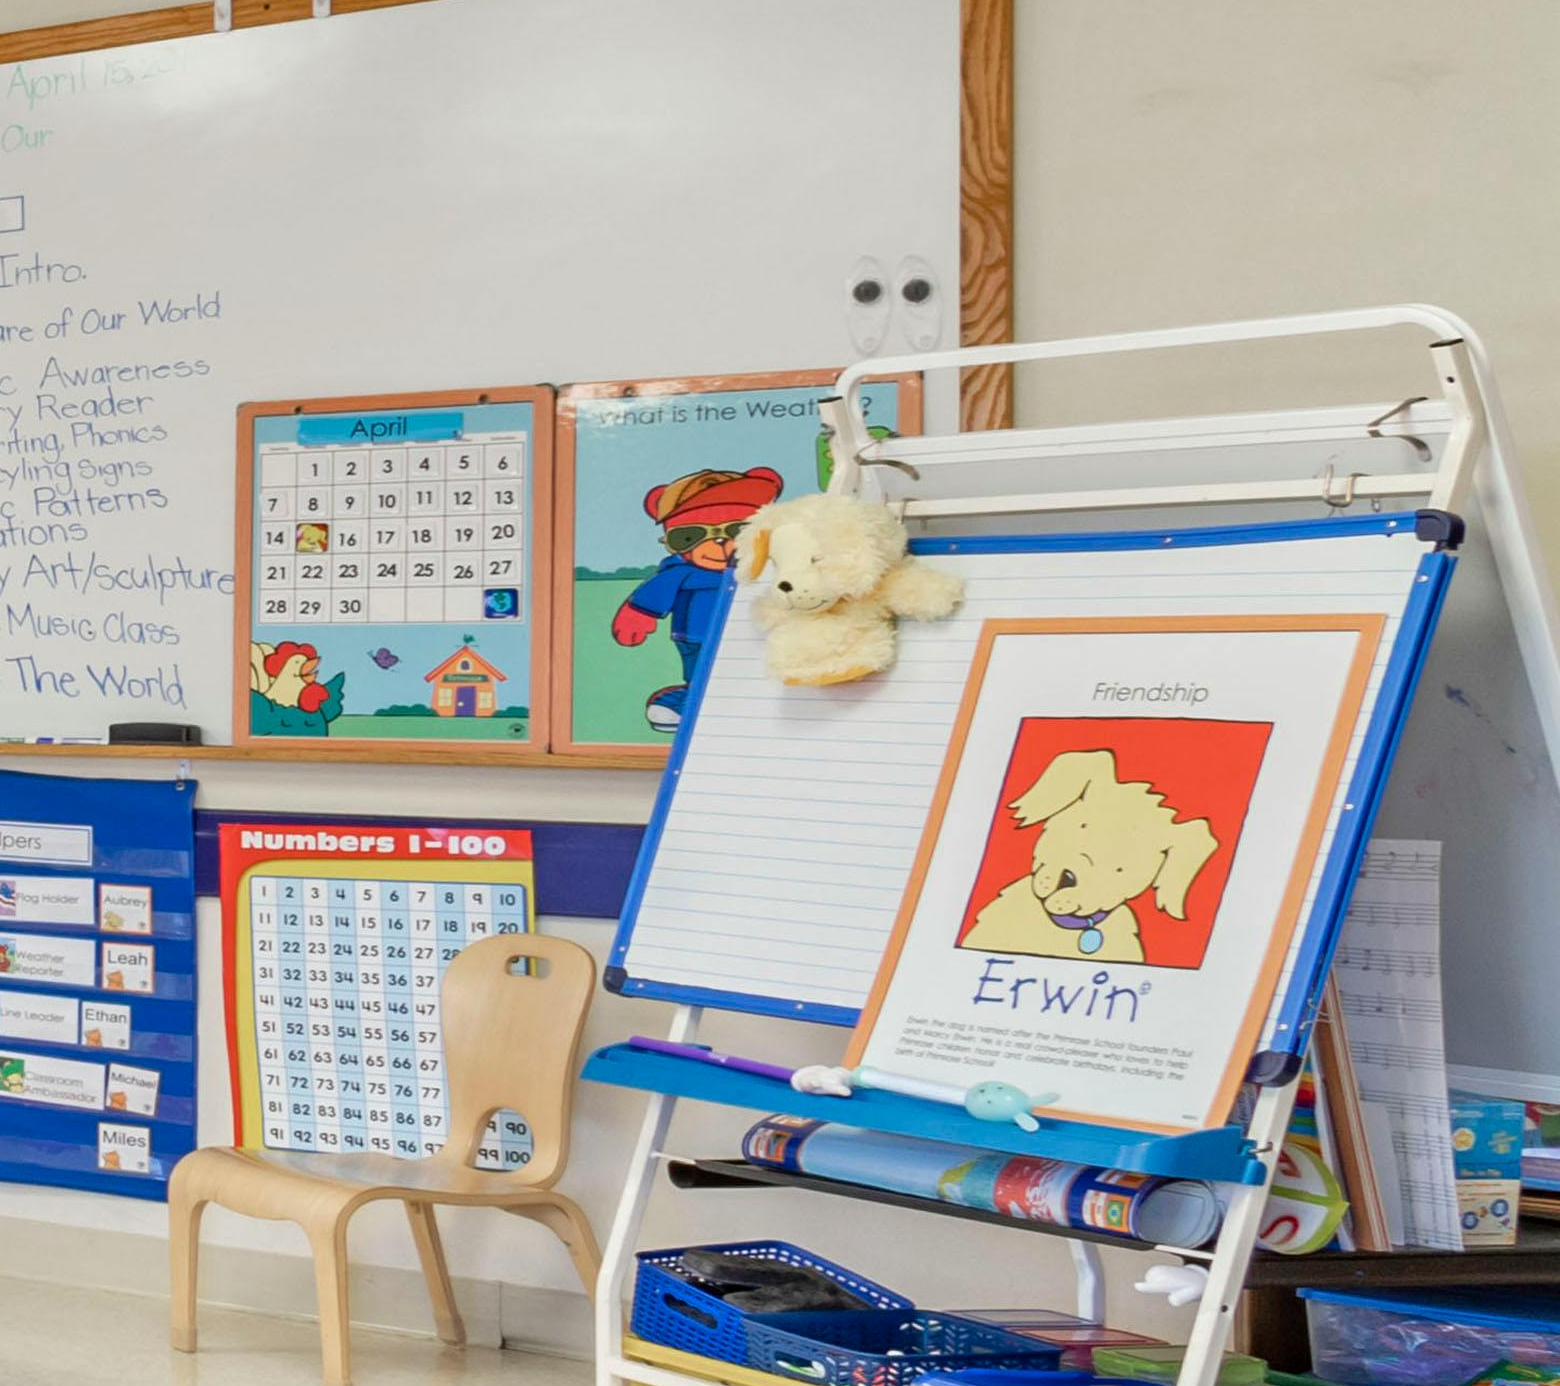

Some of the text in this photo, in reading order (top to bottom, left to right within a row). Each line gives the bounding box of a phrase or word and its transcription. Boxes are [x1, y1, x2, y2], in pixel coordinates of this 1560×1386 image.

[44, 306, 72, 339] of
[80, 307, 127, 335] Our
[138, 290, 221, 326] World
[38, 355, 211, 390] Awareness
[35, 386, 154, 421] Reader
[672, 406, 688, 423] is
[695, 403, 737, 422] the
[70, 421, 168, 450] Phonics
[349, 415, 408, 443] April
[33, 485, 169, 517] Patterns
[266, 598, 362, 616] 28 29 30
[6, 602, 97, 642] Music
[103, 610, 181, 646] Class
[5, 654, 80, 698] The
[86, 663, 188, 710] World
[1092, 681, 1210, 706] Friendship
[240, 830, 395, 854] Numbers
[103, 894, 148, 910] Aubrey
[106, 949, 148, 967] Leah
[84, 1008, 128, 1025] Ethan
[110, 1071, 156, 1090] Michael
[102, 1129, 147, 1149] Miles
[477, 1145, 531, 1164] 99 100
